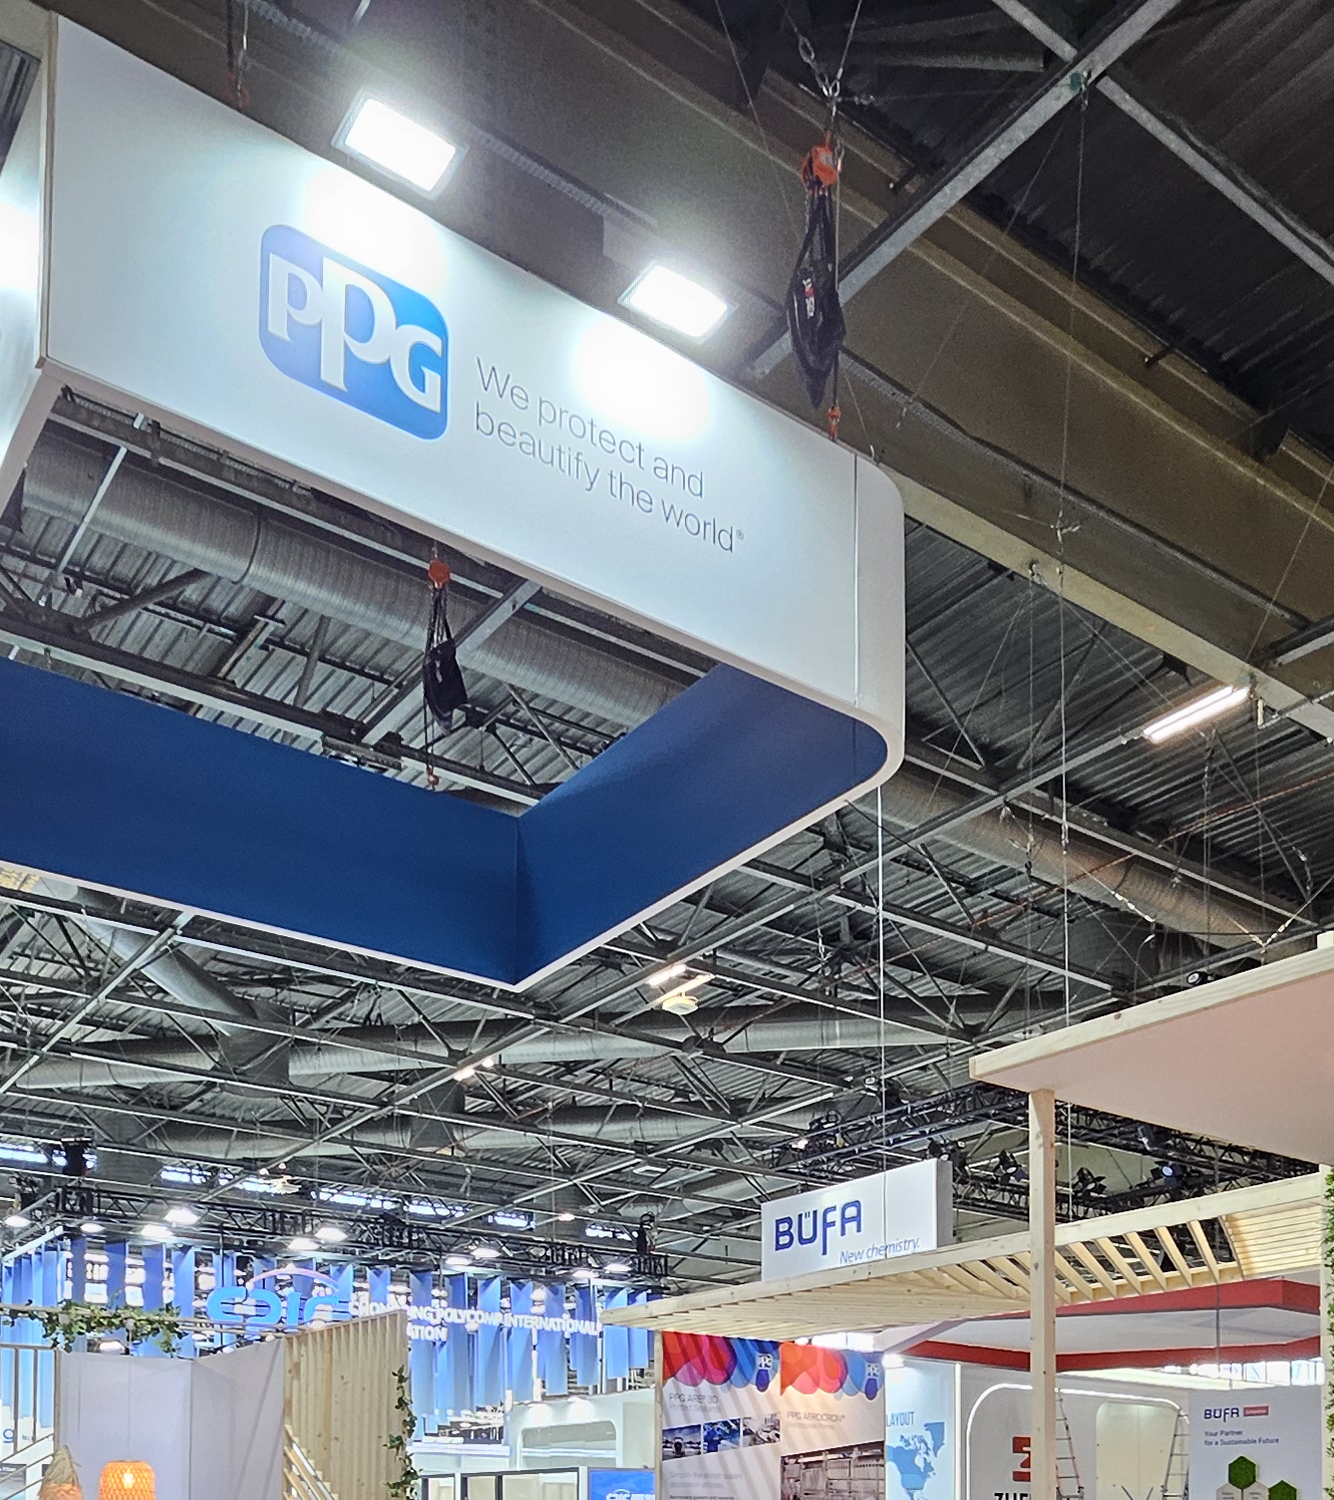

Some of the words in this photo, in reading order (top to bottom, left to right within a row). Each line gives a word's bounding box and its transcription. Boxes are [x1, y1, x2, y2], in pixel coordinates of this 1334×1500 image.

[267, 252, 442, 414] PPG
[475, 401, 600, 492] beautify
[607, 469, 653, 514] the
[476, 356, 530, 411] We
[539, 396, 645, 470] protect
[653, 456, 704, 499] and
[774, 1200, 862, 1256] BÜFA
[839, 1249, 865, 1264] New
[505, 1312, 600, 1335] INTERNATIONAL
